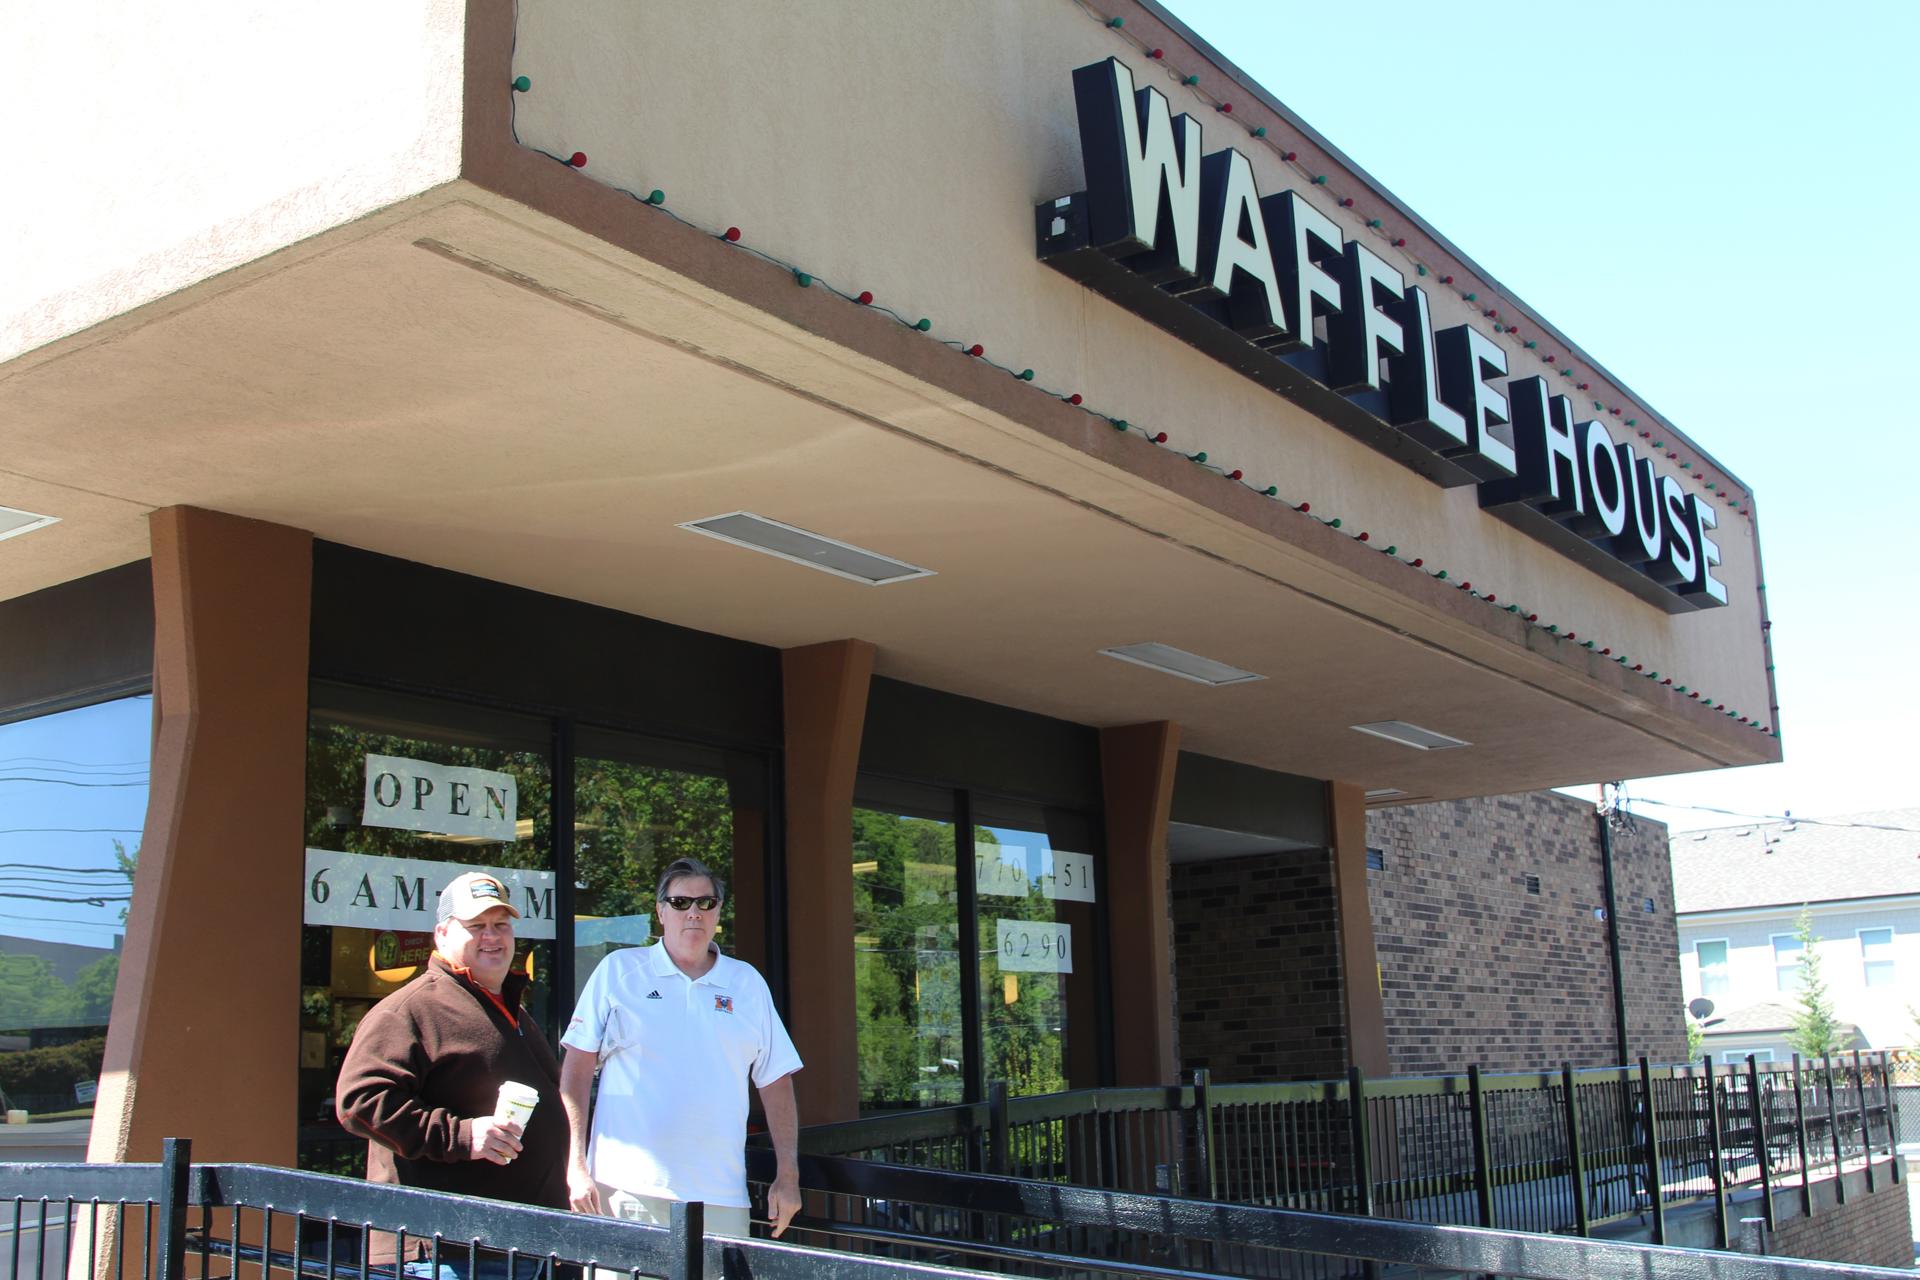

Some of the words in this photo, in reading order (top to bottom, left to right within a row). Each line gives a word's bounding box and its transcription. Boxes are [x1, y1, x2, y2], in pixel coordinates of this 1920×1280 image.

[1108, 56, 1518, 478] WAFFLE
[1536, 375, 1729, 607] HOUSE
[373, 772, 508, 821] OPEN
[310, 867, 331, 904] 6
[975, 854, 1022, 883] 770
[1047, 857, 1088, 889] 451
[400, 947, 429, 963] HERE
[1003, 932, 1066, 960] 6290
